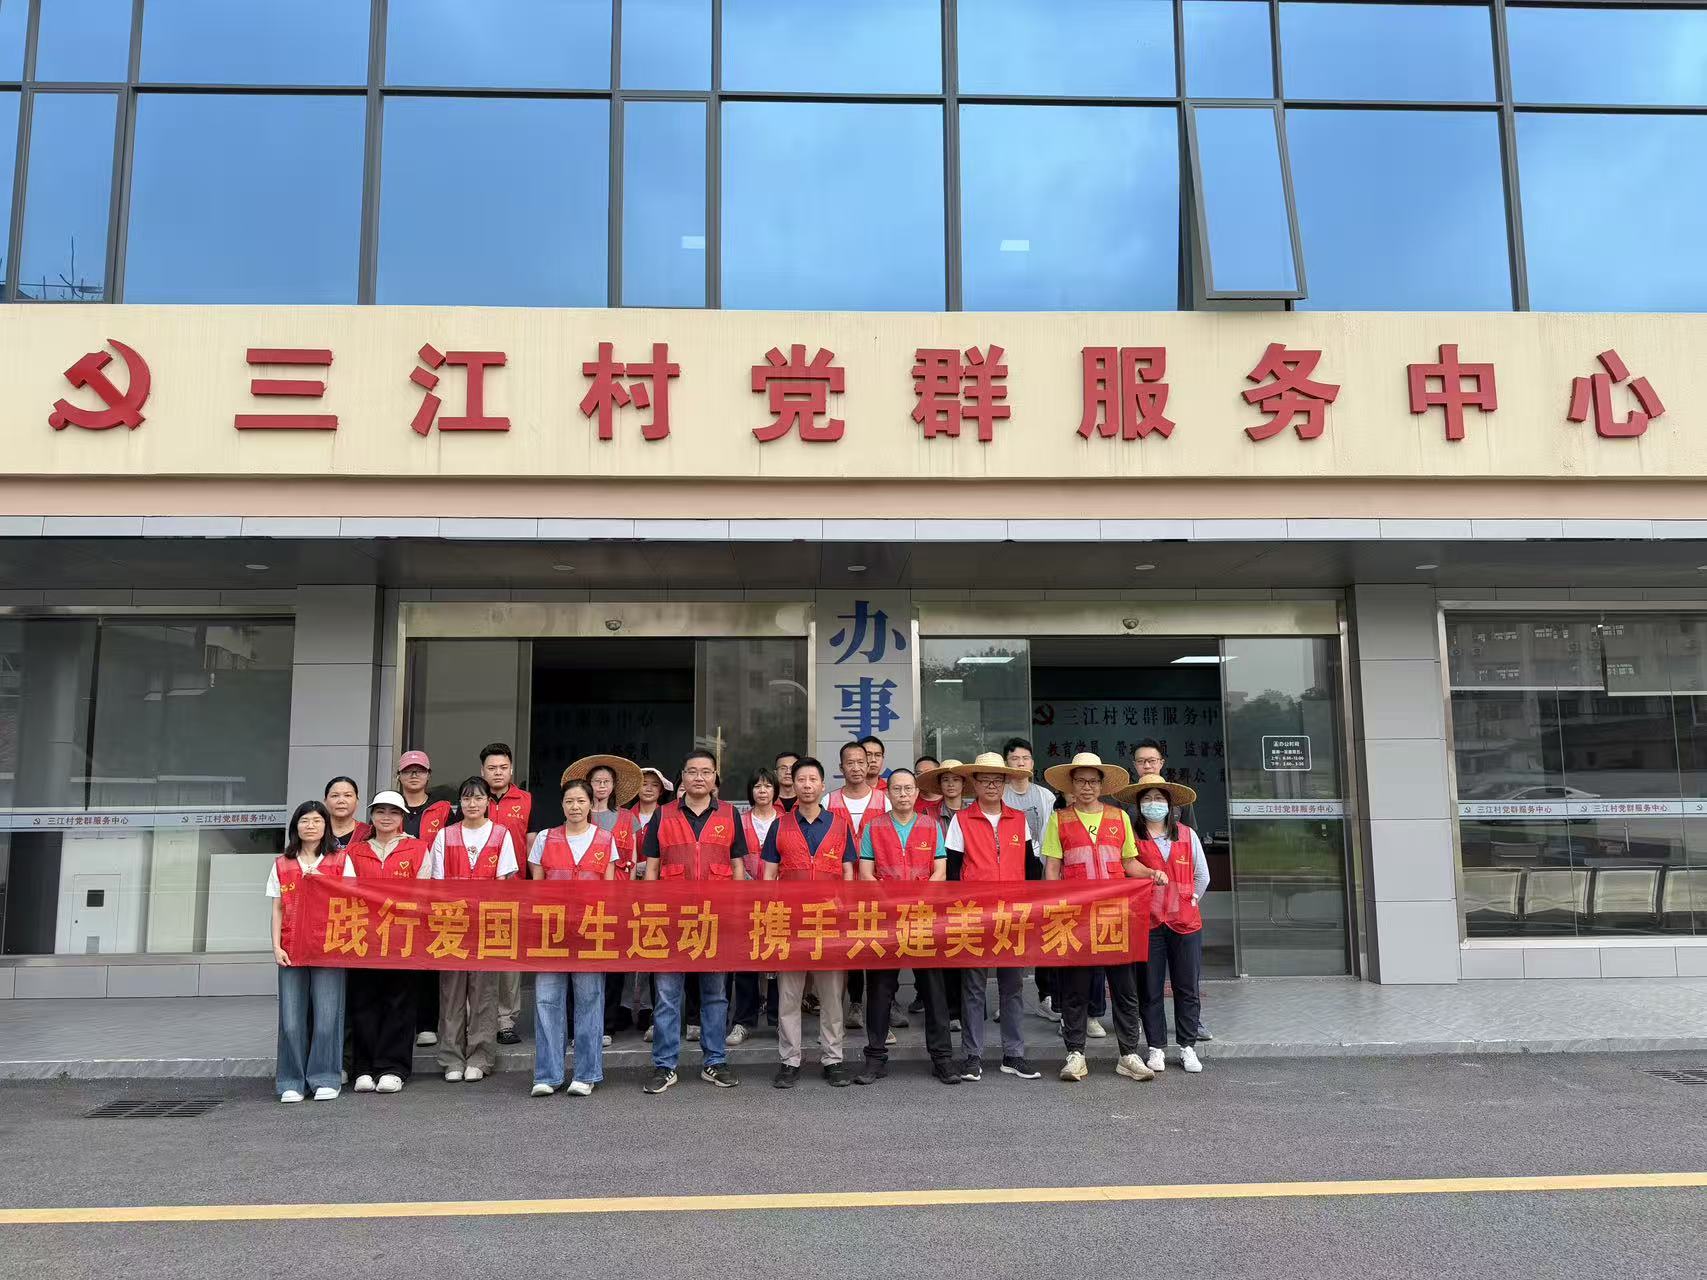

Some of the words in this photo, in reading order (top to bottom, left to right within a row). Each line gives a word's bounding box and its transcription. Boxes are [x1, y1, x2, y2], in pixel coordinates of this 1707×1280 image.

[235, 342, 1665, 442] 三江村党群服务中心
[829, 601, 906, 779] 办事
[1257, 804, 1334, 814] 三江村党群服务中心
[1476, 806, 1552, 814] 三江村党群服务中心
[1593, 804, 1668, 813] 三江村党群服务中心
[47, 815, 129, 825] 三江村党群服务中心
[195, 814, 277, 824] 三江村党群服务中心
[323, 897, 719, 960] 践行爱国卫生运动
[749, 897, 1130, 960] 携手共建美好家园
